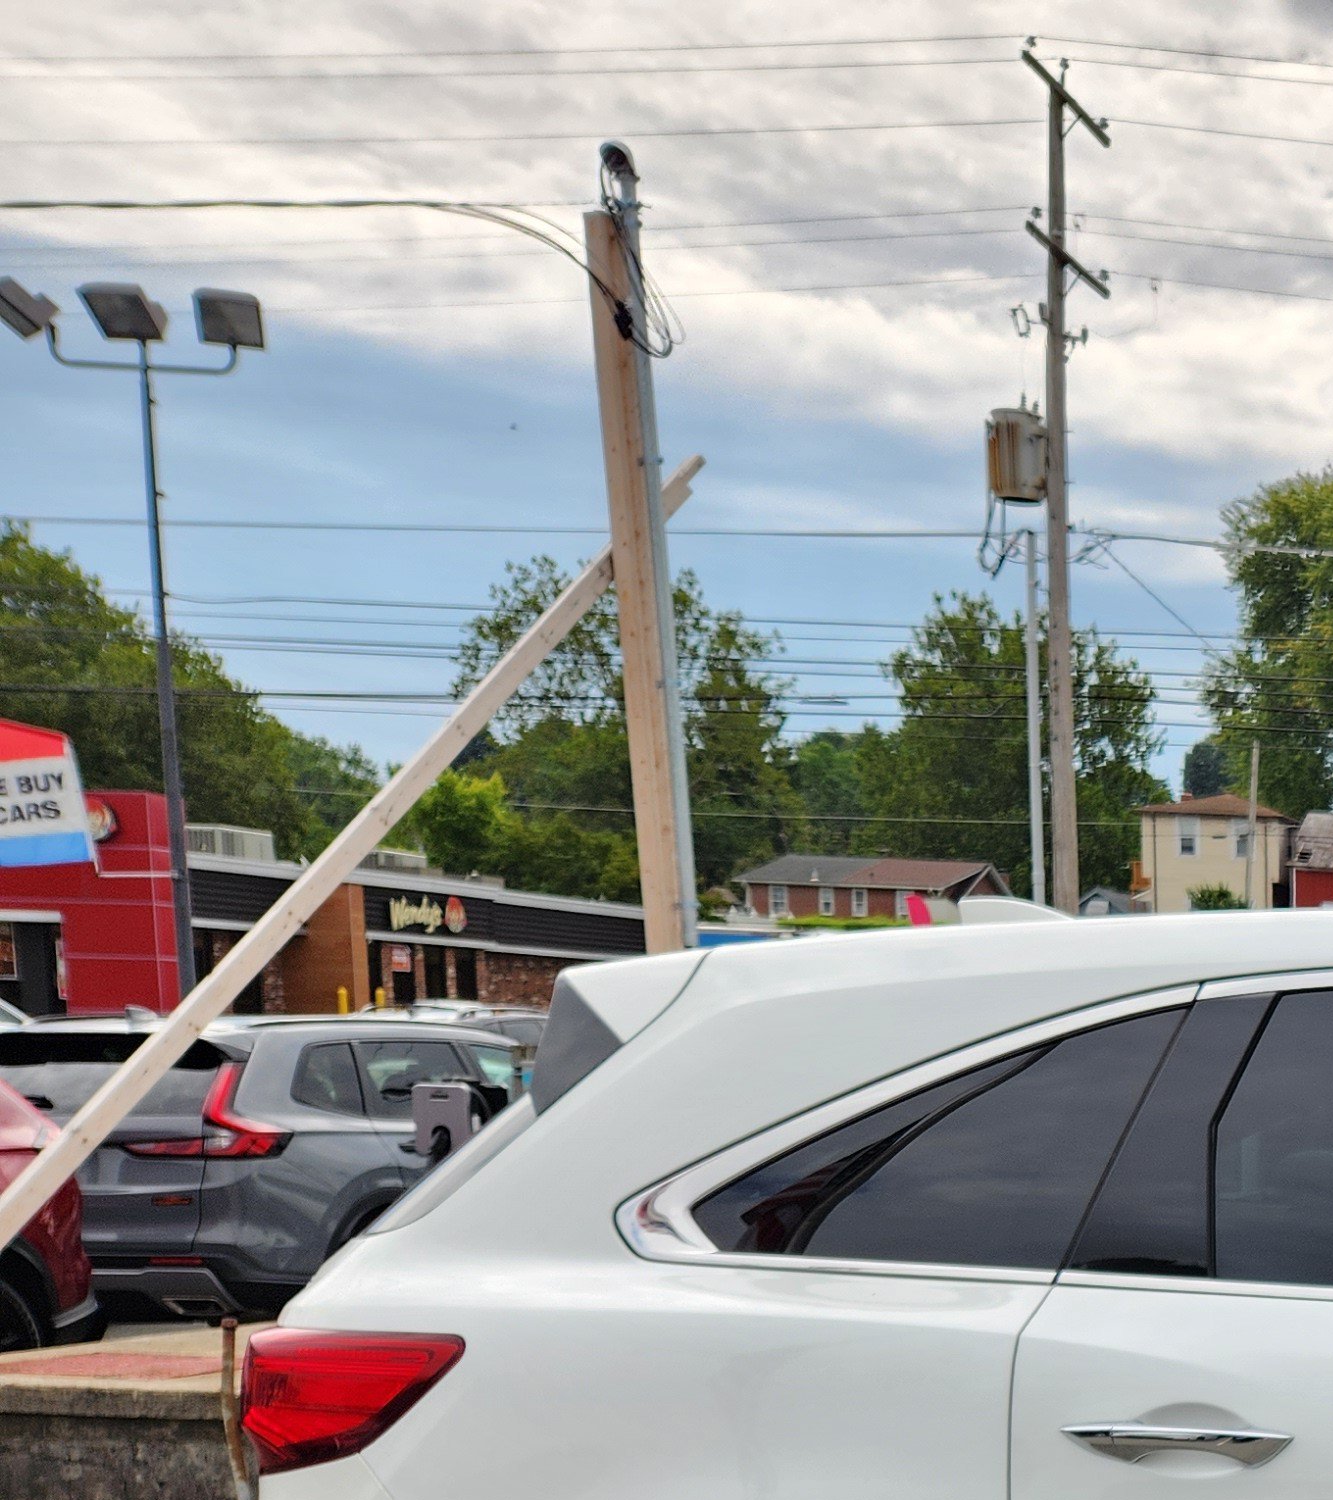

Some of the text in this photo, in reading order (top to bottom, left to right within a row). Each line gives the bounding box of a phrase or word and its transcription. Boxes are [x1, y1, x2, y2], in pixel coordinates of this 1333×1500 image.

[16, 772, 64, 795] BUY
[0, 800, 61, 825] CARS
[389, 894, 443, 935] Wendy's
